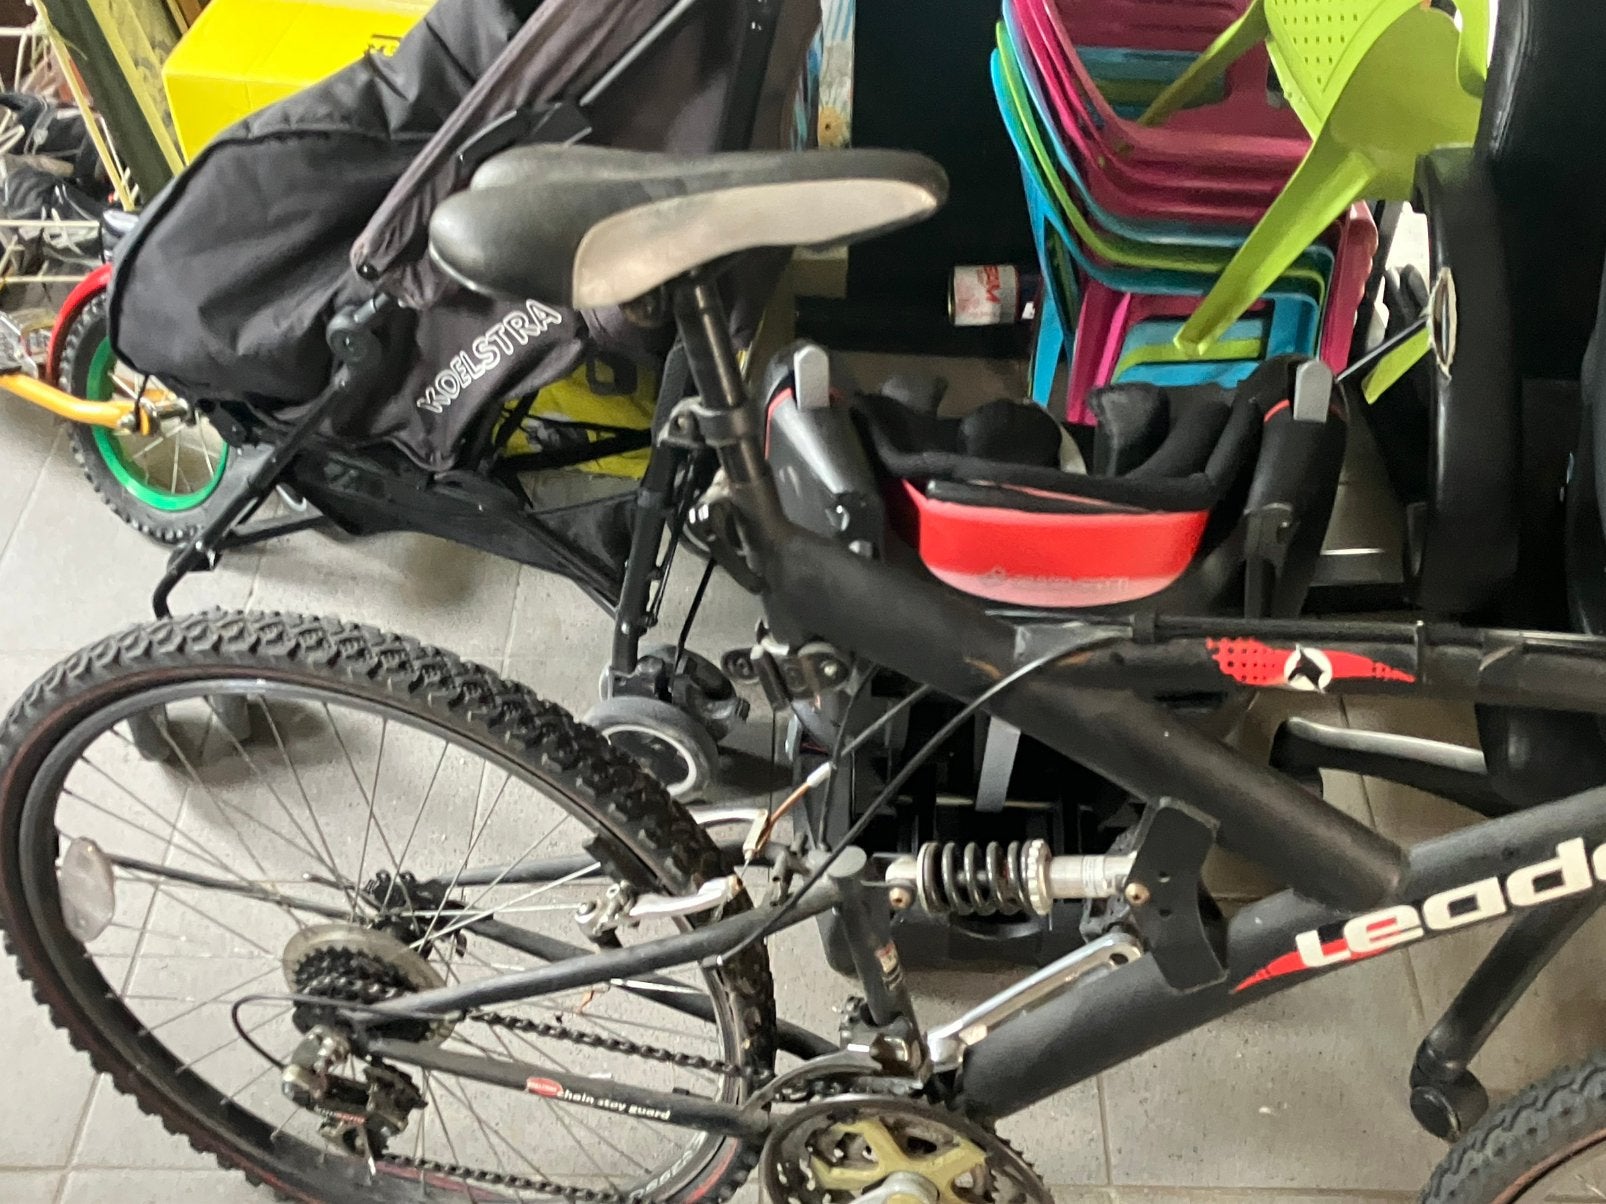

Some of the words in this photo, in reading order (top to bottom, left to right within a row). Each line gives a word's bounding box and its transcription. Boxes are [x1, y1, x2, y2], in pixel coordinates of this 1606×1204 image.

[417, 299, 562, 413] KOELSTRA
[1295, 837, 1606, 968] Lead
[598, 1098, 627, 1112] stay
[628, 1104, 671, 1121] guard
